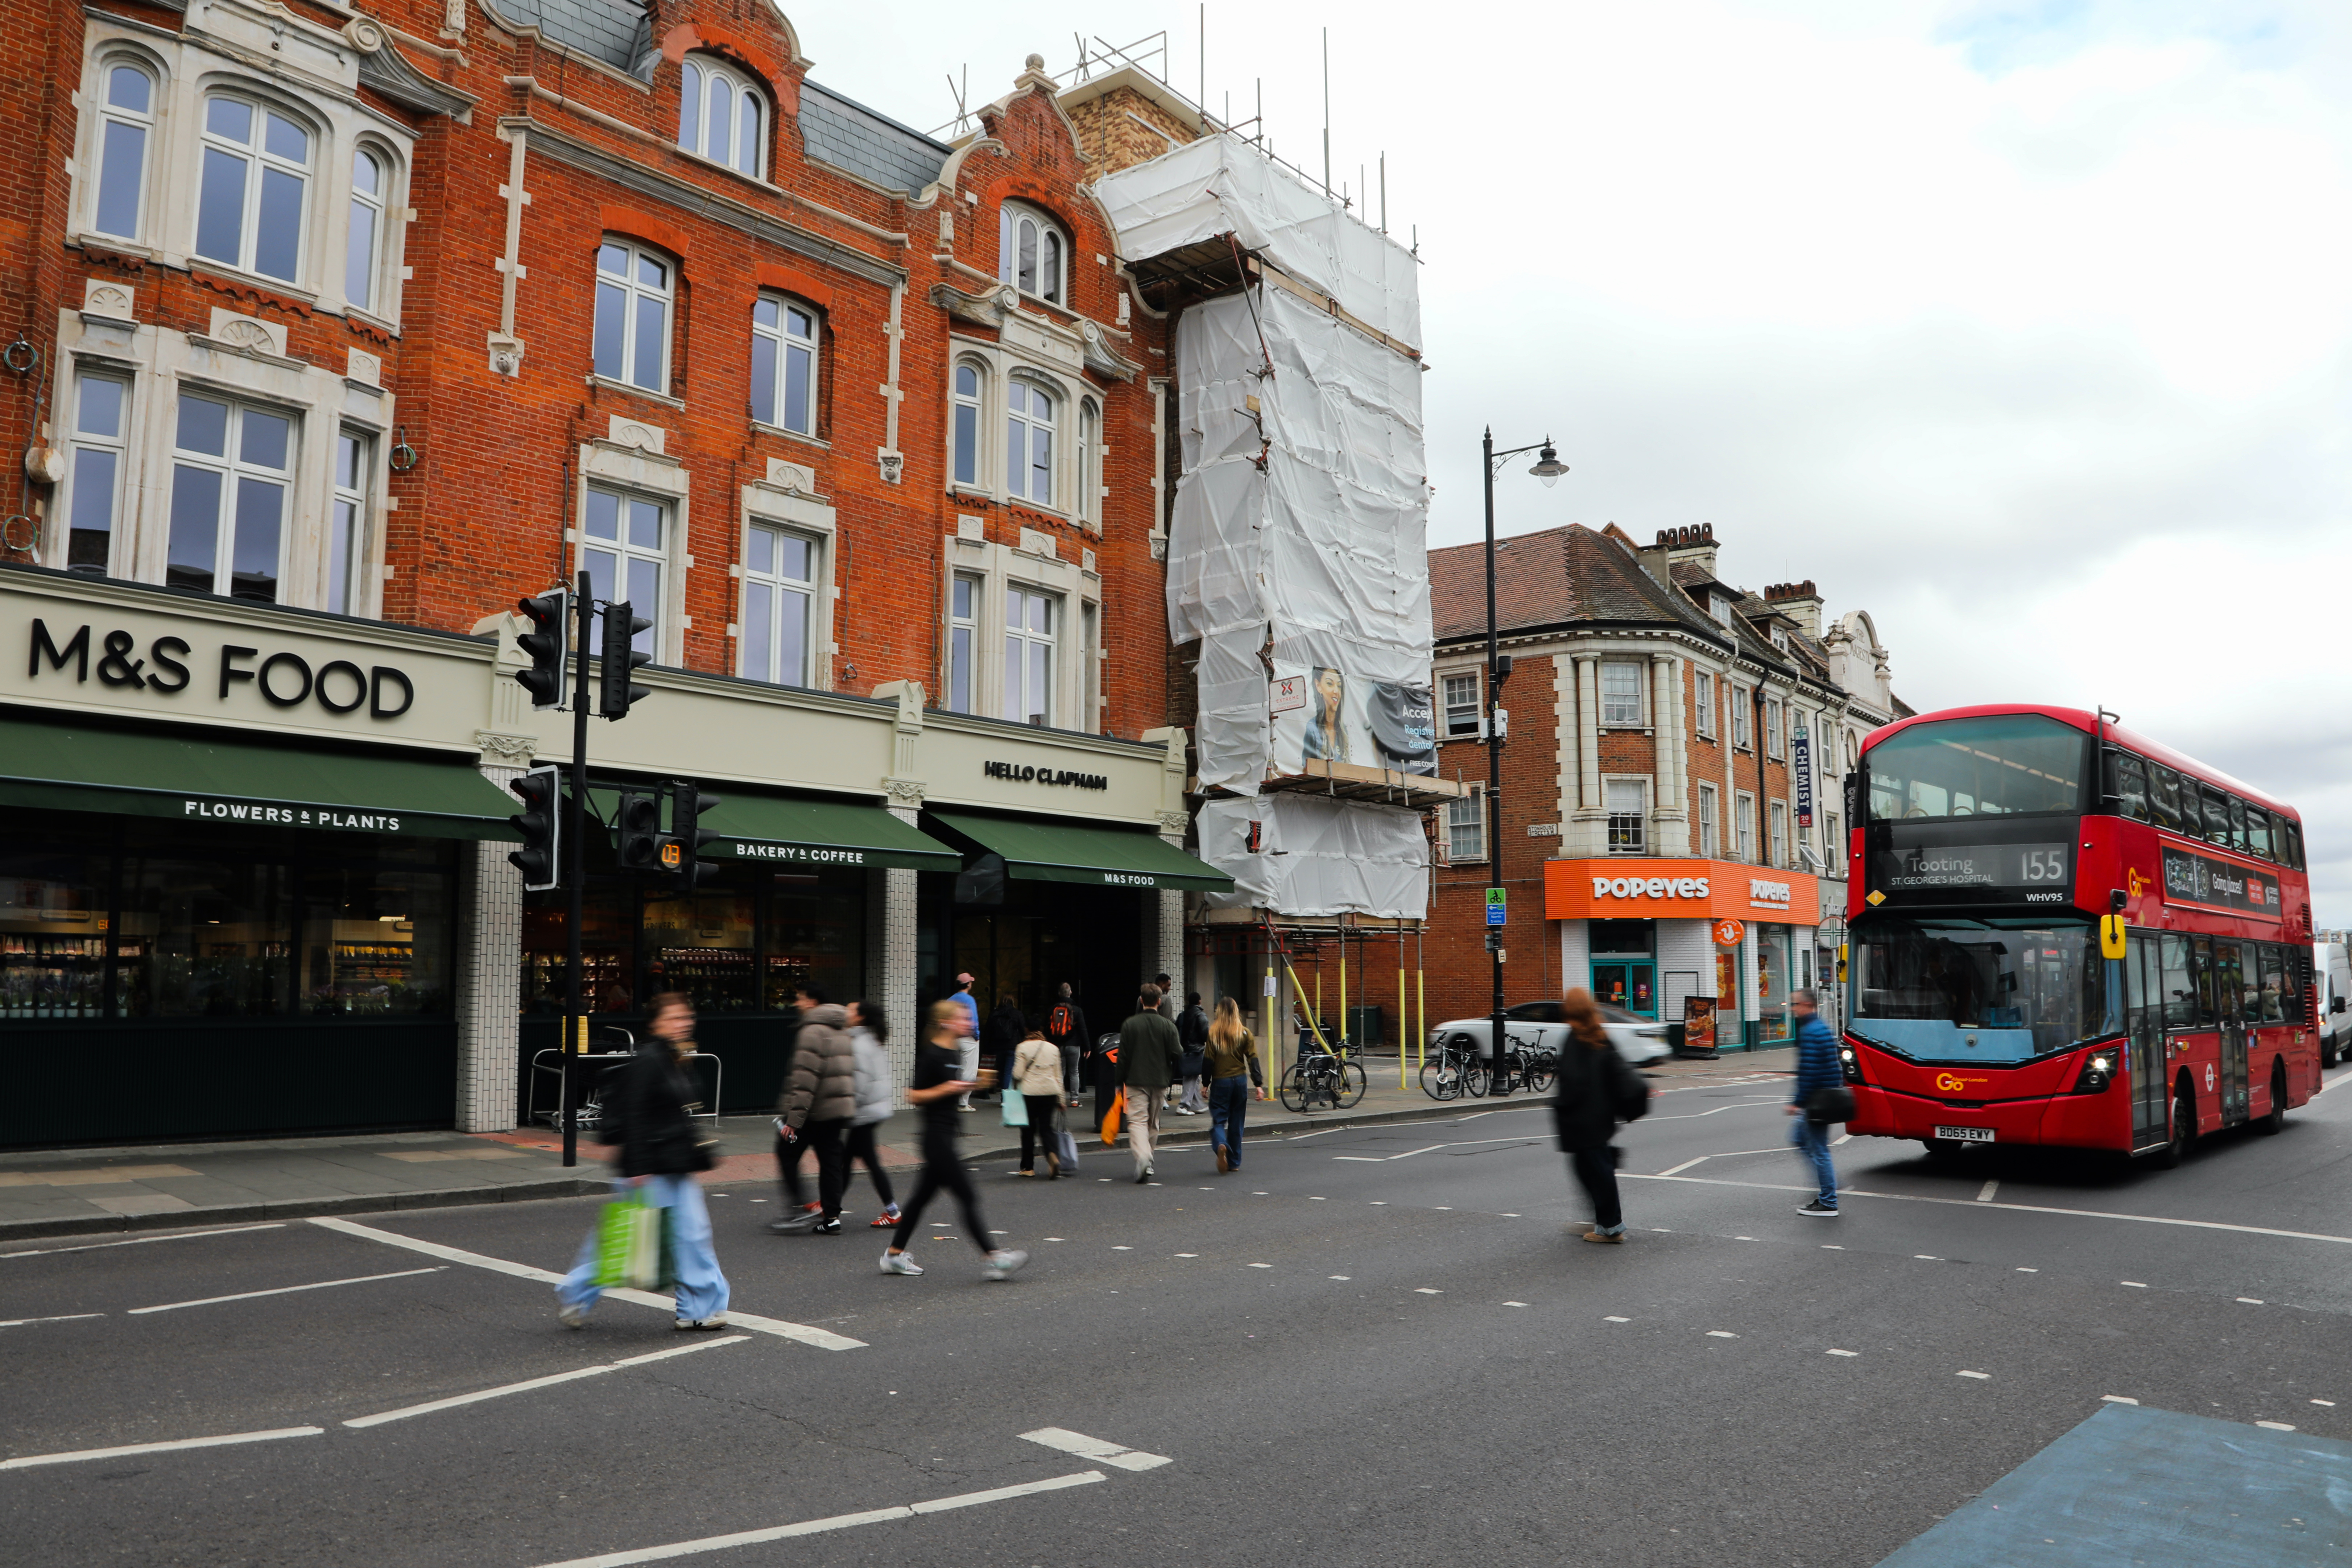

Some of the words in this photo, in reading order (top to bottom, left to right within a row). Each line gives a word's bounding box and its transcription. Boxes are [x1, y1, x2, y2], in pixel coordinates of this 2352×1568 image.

[29, 617, 191, 694] M&S
[219, 644, 414, 718] FOOD
[985, 760, 1036, 781] HELLO
[1036, 768, 1107, 791] CLAPHAM
[1797, 746, 1810, 807] CHEMIST
[185, 801, 293, 822] FLOWERS
[301, 811, 310, 823] &
[319, 812, 400, 831] PLANTS
[737, 844, 795, 859] BAKERY
[799, 849, 806, 860] &
[811, 850, 863, 863] COFFEE
[1909, 857, 1973, 874] Tooting
[2022, 851, 2062, 880] 155
[1105, 872, 1126, 884] M&S
[1128, 874, 1154, 886] FOOD
[1904, 876, 1947, 884] GEORGE'S
[1950, 874, 1993, 883] HOSPITAL
[2212, 873, 2227, 895] Going
[1936, 1072, 1964, 1091] Go
[1940, 1127, 1966, 1138] BD65
[1969, 1129, 1989, 1139] EWY
